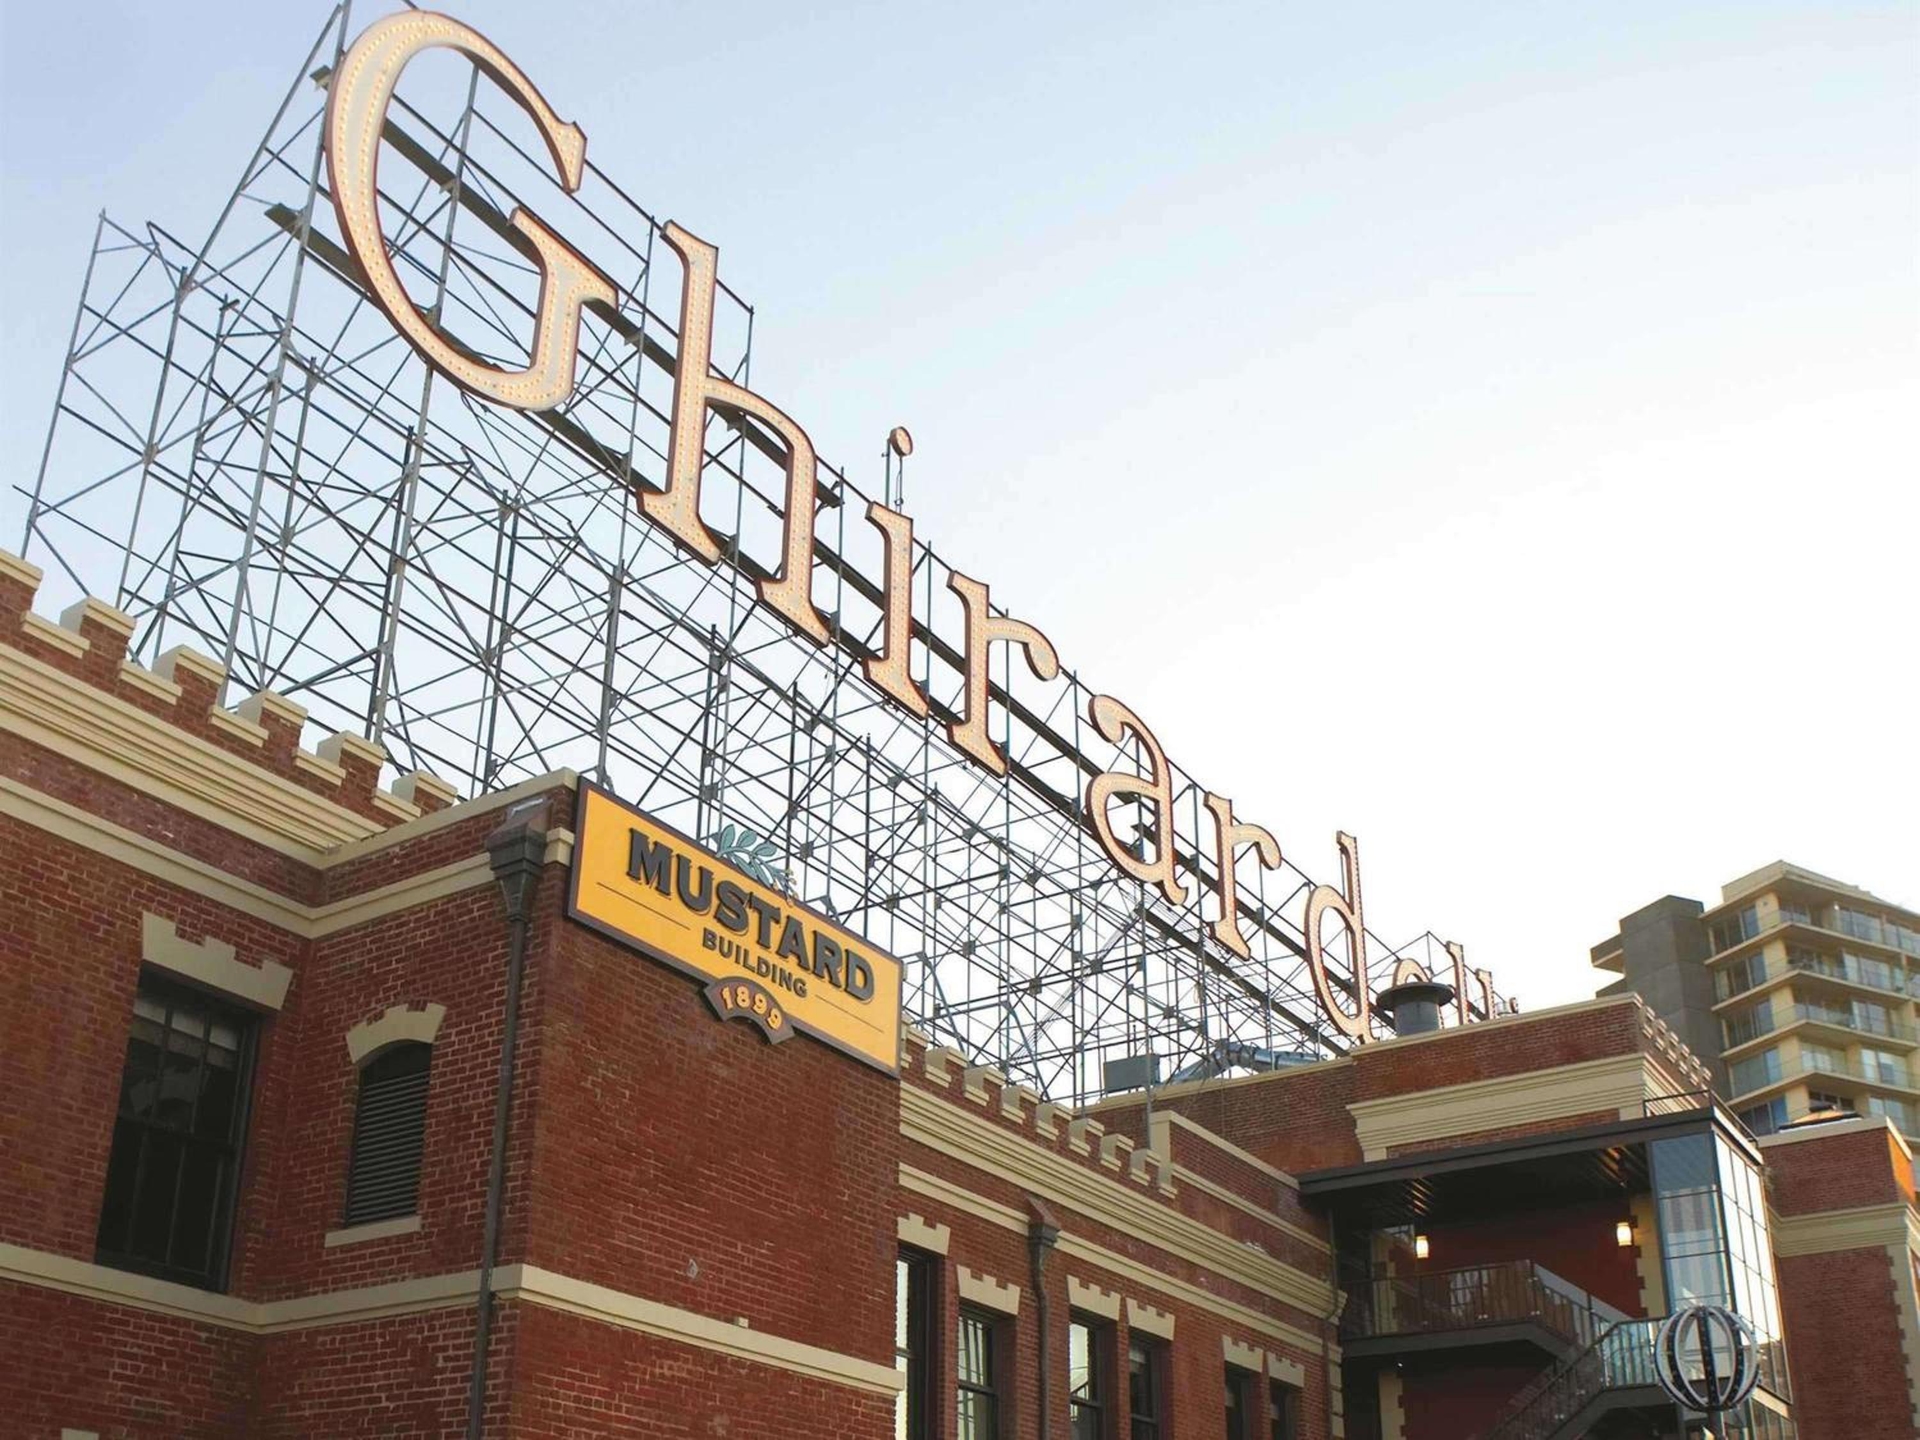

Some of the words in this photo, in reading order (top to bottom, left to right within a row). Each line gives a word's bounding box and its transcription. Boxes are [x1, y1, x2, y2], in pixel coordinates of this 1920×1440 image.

[627, 828, 874, 1002] MUSTARD
[703, 928, 807, 997] BUILDING
[721, 987, 782, 1029] 1899
